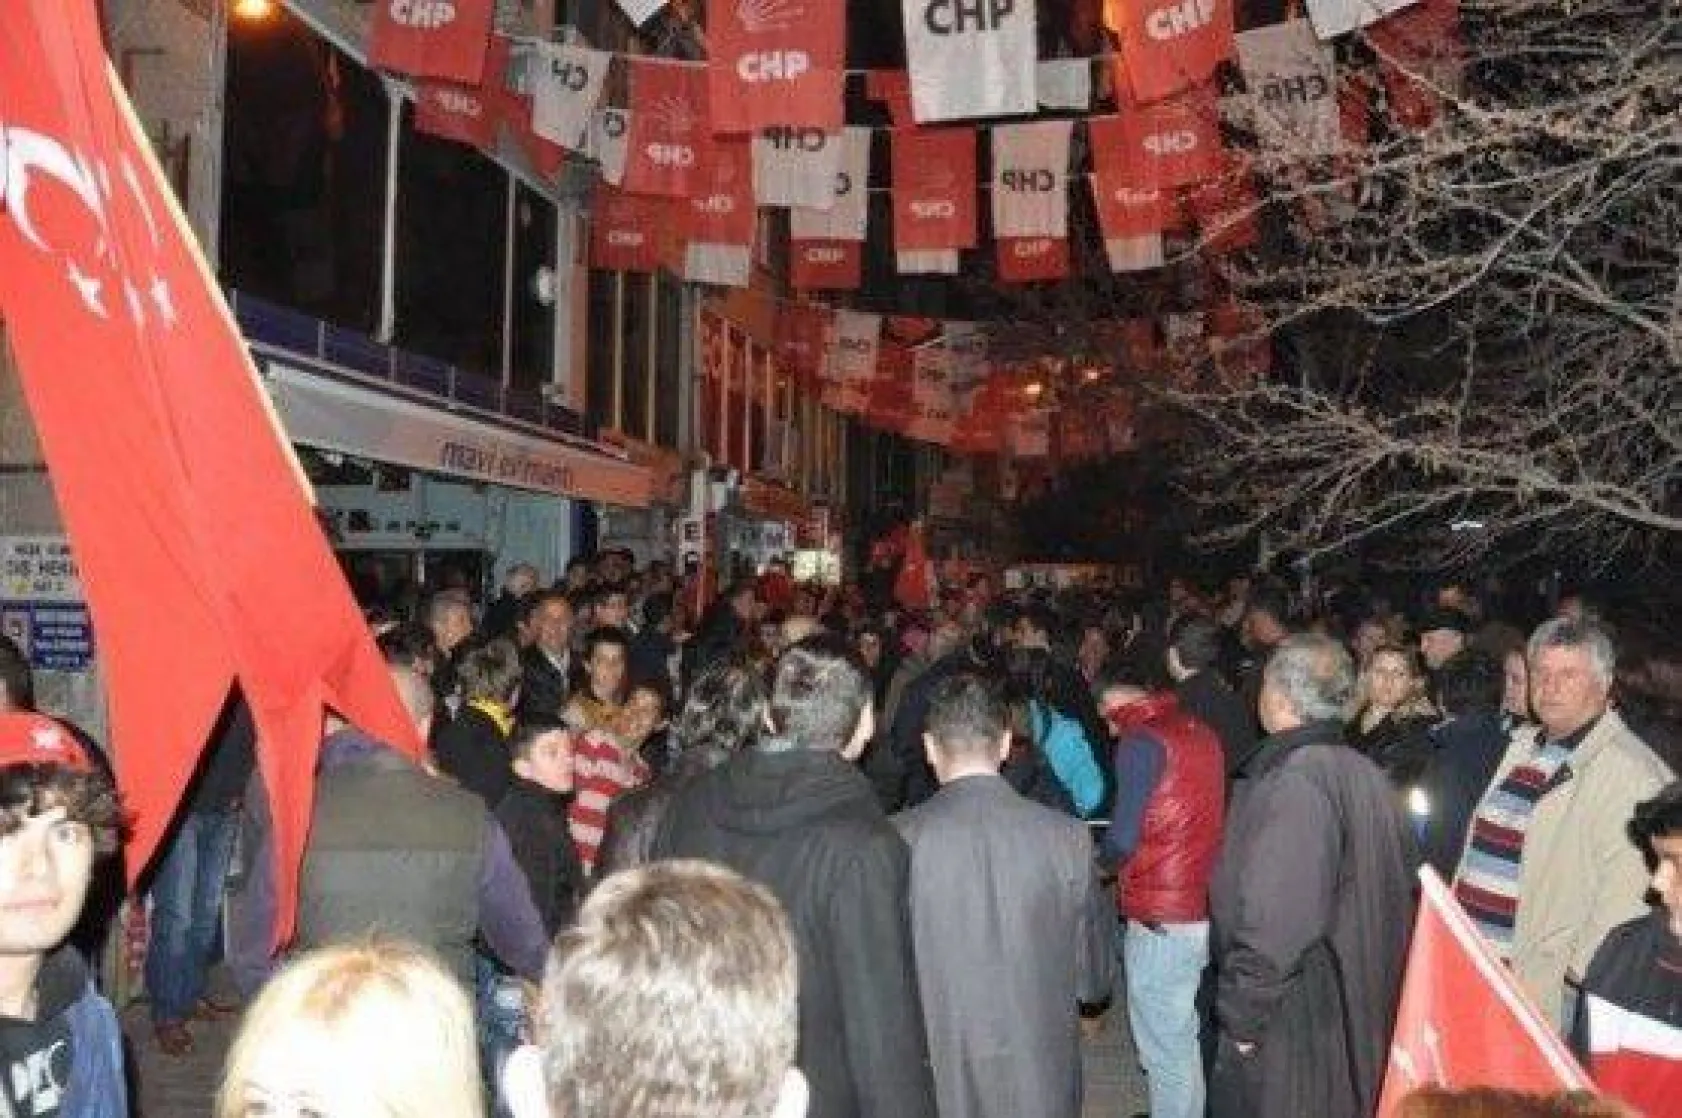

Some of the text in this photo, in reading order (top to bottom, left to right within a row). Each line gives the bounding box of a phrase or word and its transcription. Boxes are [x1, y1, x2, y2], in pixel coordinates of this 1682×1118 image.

[390, 0, 456, 28] CHP
[924, 0, 1015, 35] CHP
[737, 48, 809, 82] CHP
[1014, 241, 1053, 258] CHP
